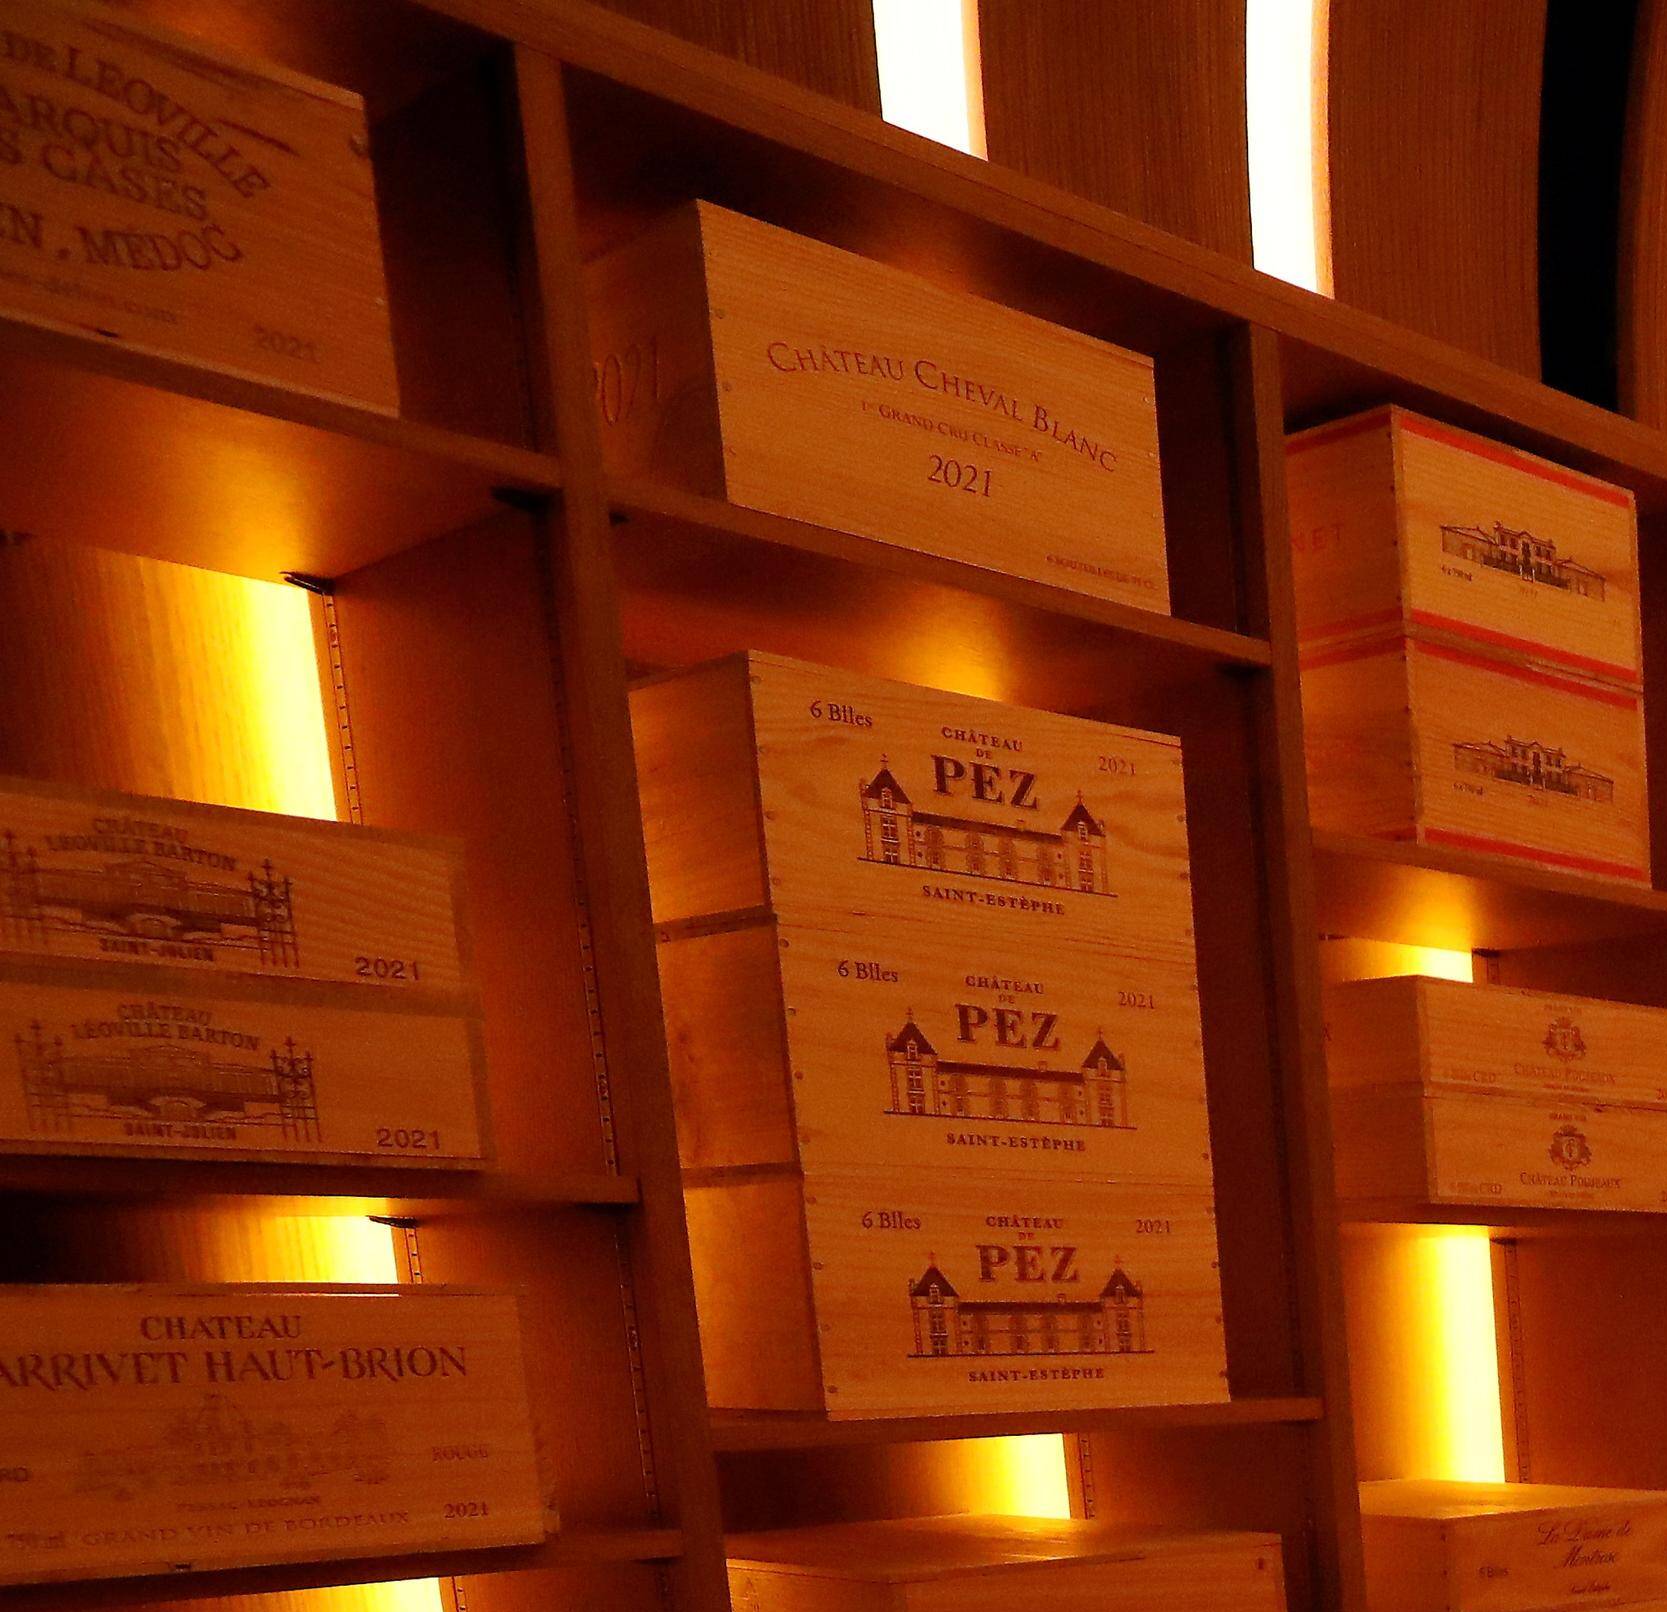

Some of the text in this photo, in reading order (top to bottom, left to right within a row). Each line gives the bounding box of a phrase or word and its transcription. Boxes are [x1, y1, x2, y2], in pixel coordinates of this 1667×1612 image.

[64, 45, 271, 199] LEOVILLE
[41, 142, 209, 222] CASES
[913, 358, 1118, 474] CHEVAL BLANC
[927, 453, 992, 498] 2021
[809, 700, 823, 720] 6
[930, 753, 1041, 813] PEZ
[354, 956, 421, 981] 2021
[837, 959, 850, 979] 6
[176, 1021, 260, 1051] BARTON
[953, 1002, 1063, 1052] PEZ
[376, 1127, 441, 1151] 2021
[861, 1211, 874, 1230] 6
[975, 1242, 1081, 1284] PEZ
[203, 1346, 469, 1385] HAUT-BRION
[82, 1527, 178, 1548] GRAND
[244, 1519, 277, 1536] DE
[284, 1510, 411, 1533] BORDEAUX
